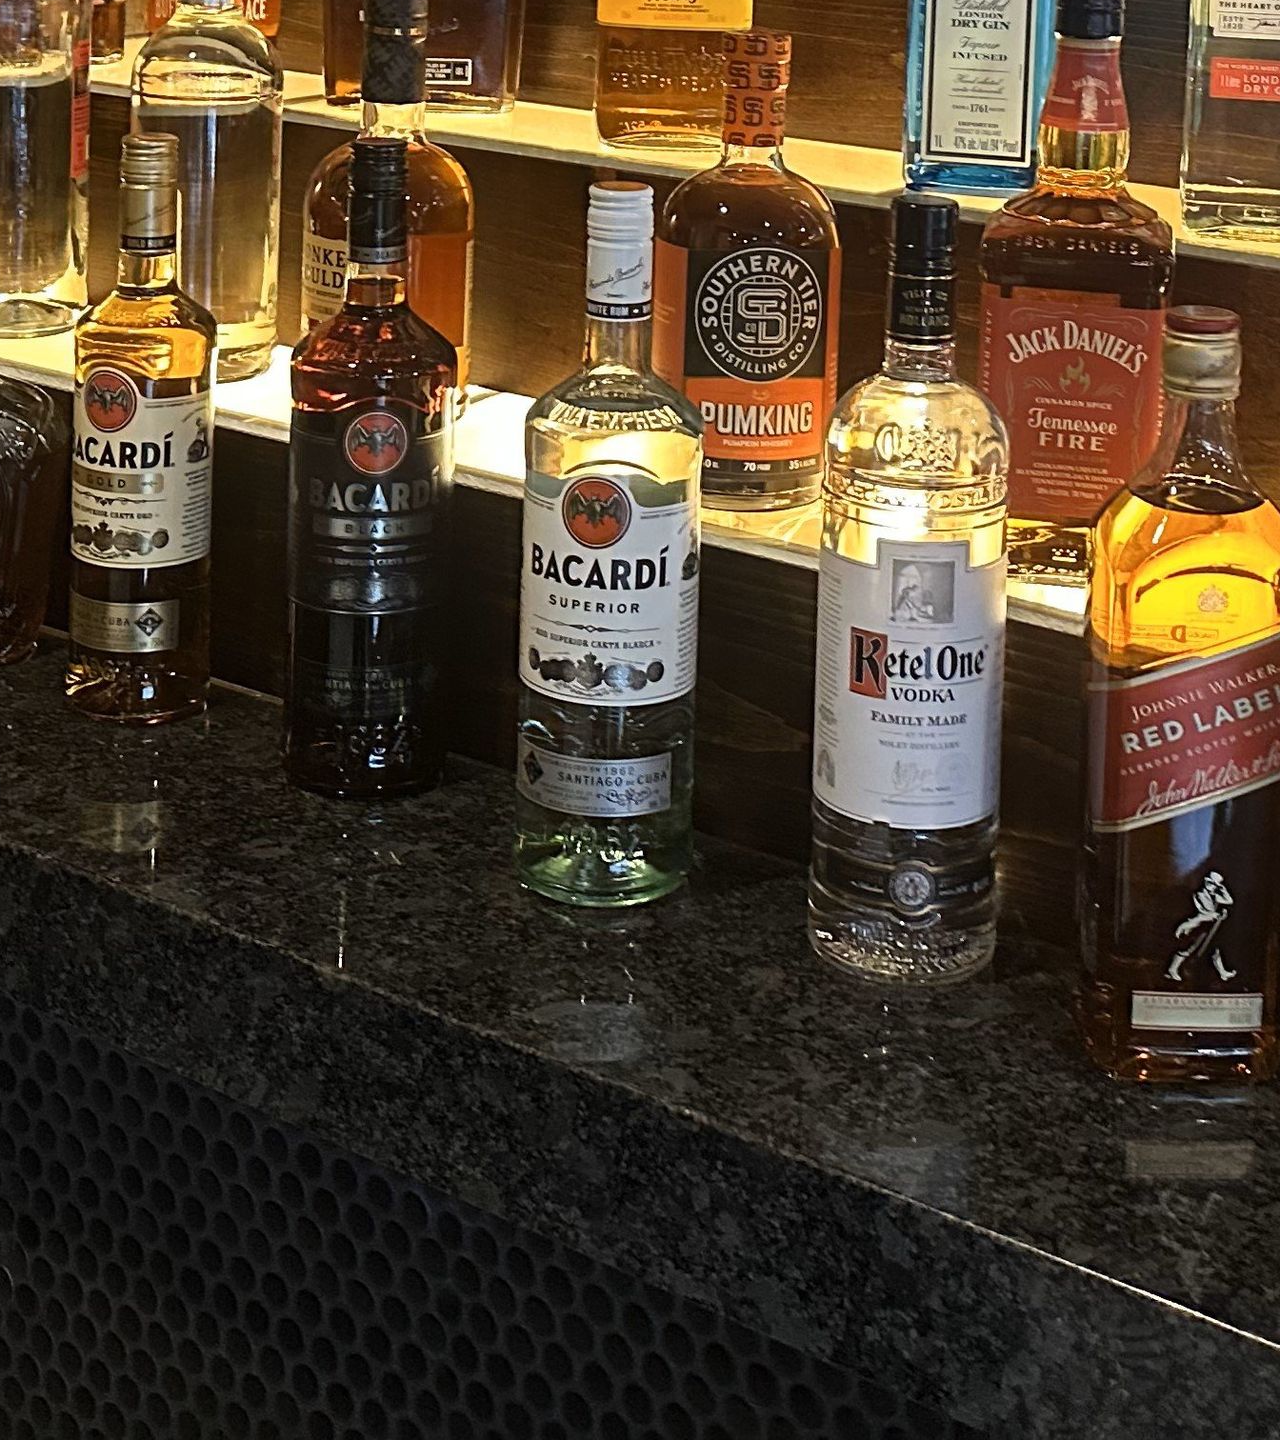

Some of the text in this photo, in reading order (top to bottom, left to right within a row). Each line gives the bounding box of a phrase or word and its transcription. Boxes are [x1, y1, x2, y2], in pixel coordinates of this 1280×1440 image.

[958, 10, 1004, 19] LONDON
[1219, 1, 1238, 9] THE
[1240, 2, 1272, 10] HEART
[951, 19, 1010, 31] DRY GIN
[952, 51, 1007, 62] INFUSED
[1243, 84, 1269, 94] DRY
[312, 244, 346, 268] NKE
[701, 254, 800, 329] SOUTHERN
[797, 275, 817, 330] TIER
[712, 341, 805, 375] DISTILLING CO
[1006, 319, 1148, 375] JACK DANIEL'S
[700, 401, 813, 436] PUMKING
[1028, 407, 1118, 435] Tennessee
[75, 431, 172, 470] ACARDÍ
[1039, 431, 1106, 453] FIRE
[743, 462, 756, 472] 70
[87, 472, 127, 488] GOLD
[309, 465, 439, 513] BACARDÍ
[344, 523, 406, 535] BLACK
[531, 542, 669, 591] BACARDÍ
[548, 594, 640, 614] SUPERIOR
[853, 633, 985, 695] Ketel One
[890, 686, 956, 703] VODKA
[1130, 663, 1277, 724] JOHNNIE WALKER
[870, 710, 968, 727] FAMILY MADE
[1121, 719, 1184, 754] RED
[557, 772, 623, 787] SANTIAGO
[637, 770, 668, 785] CUBA
